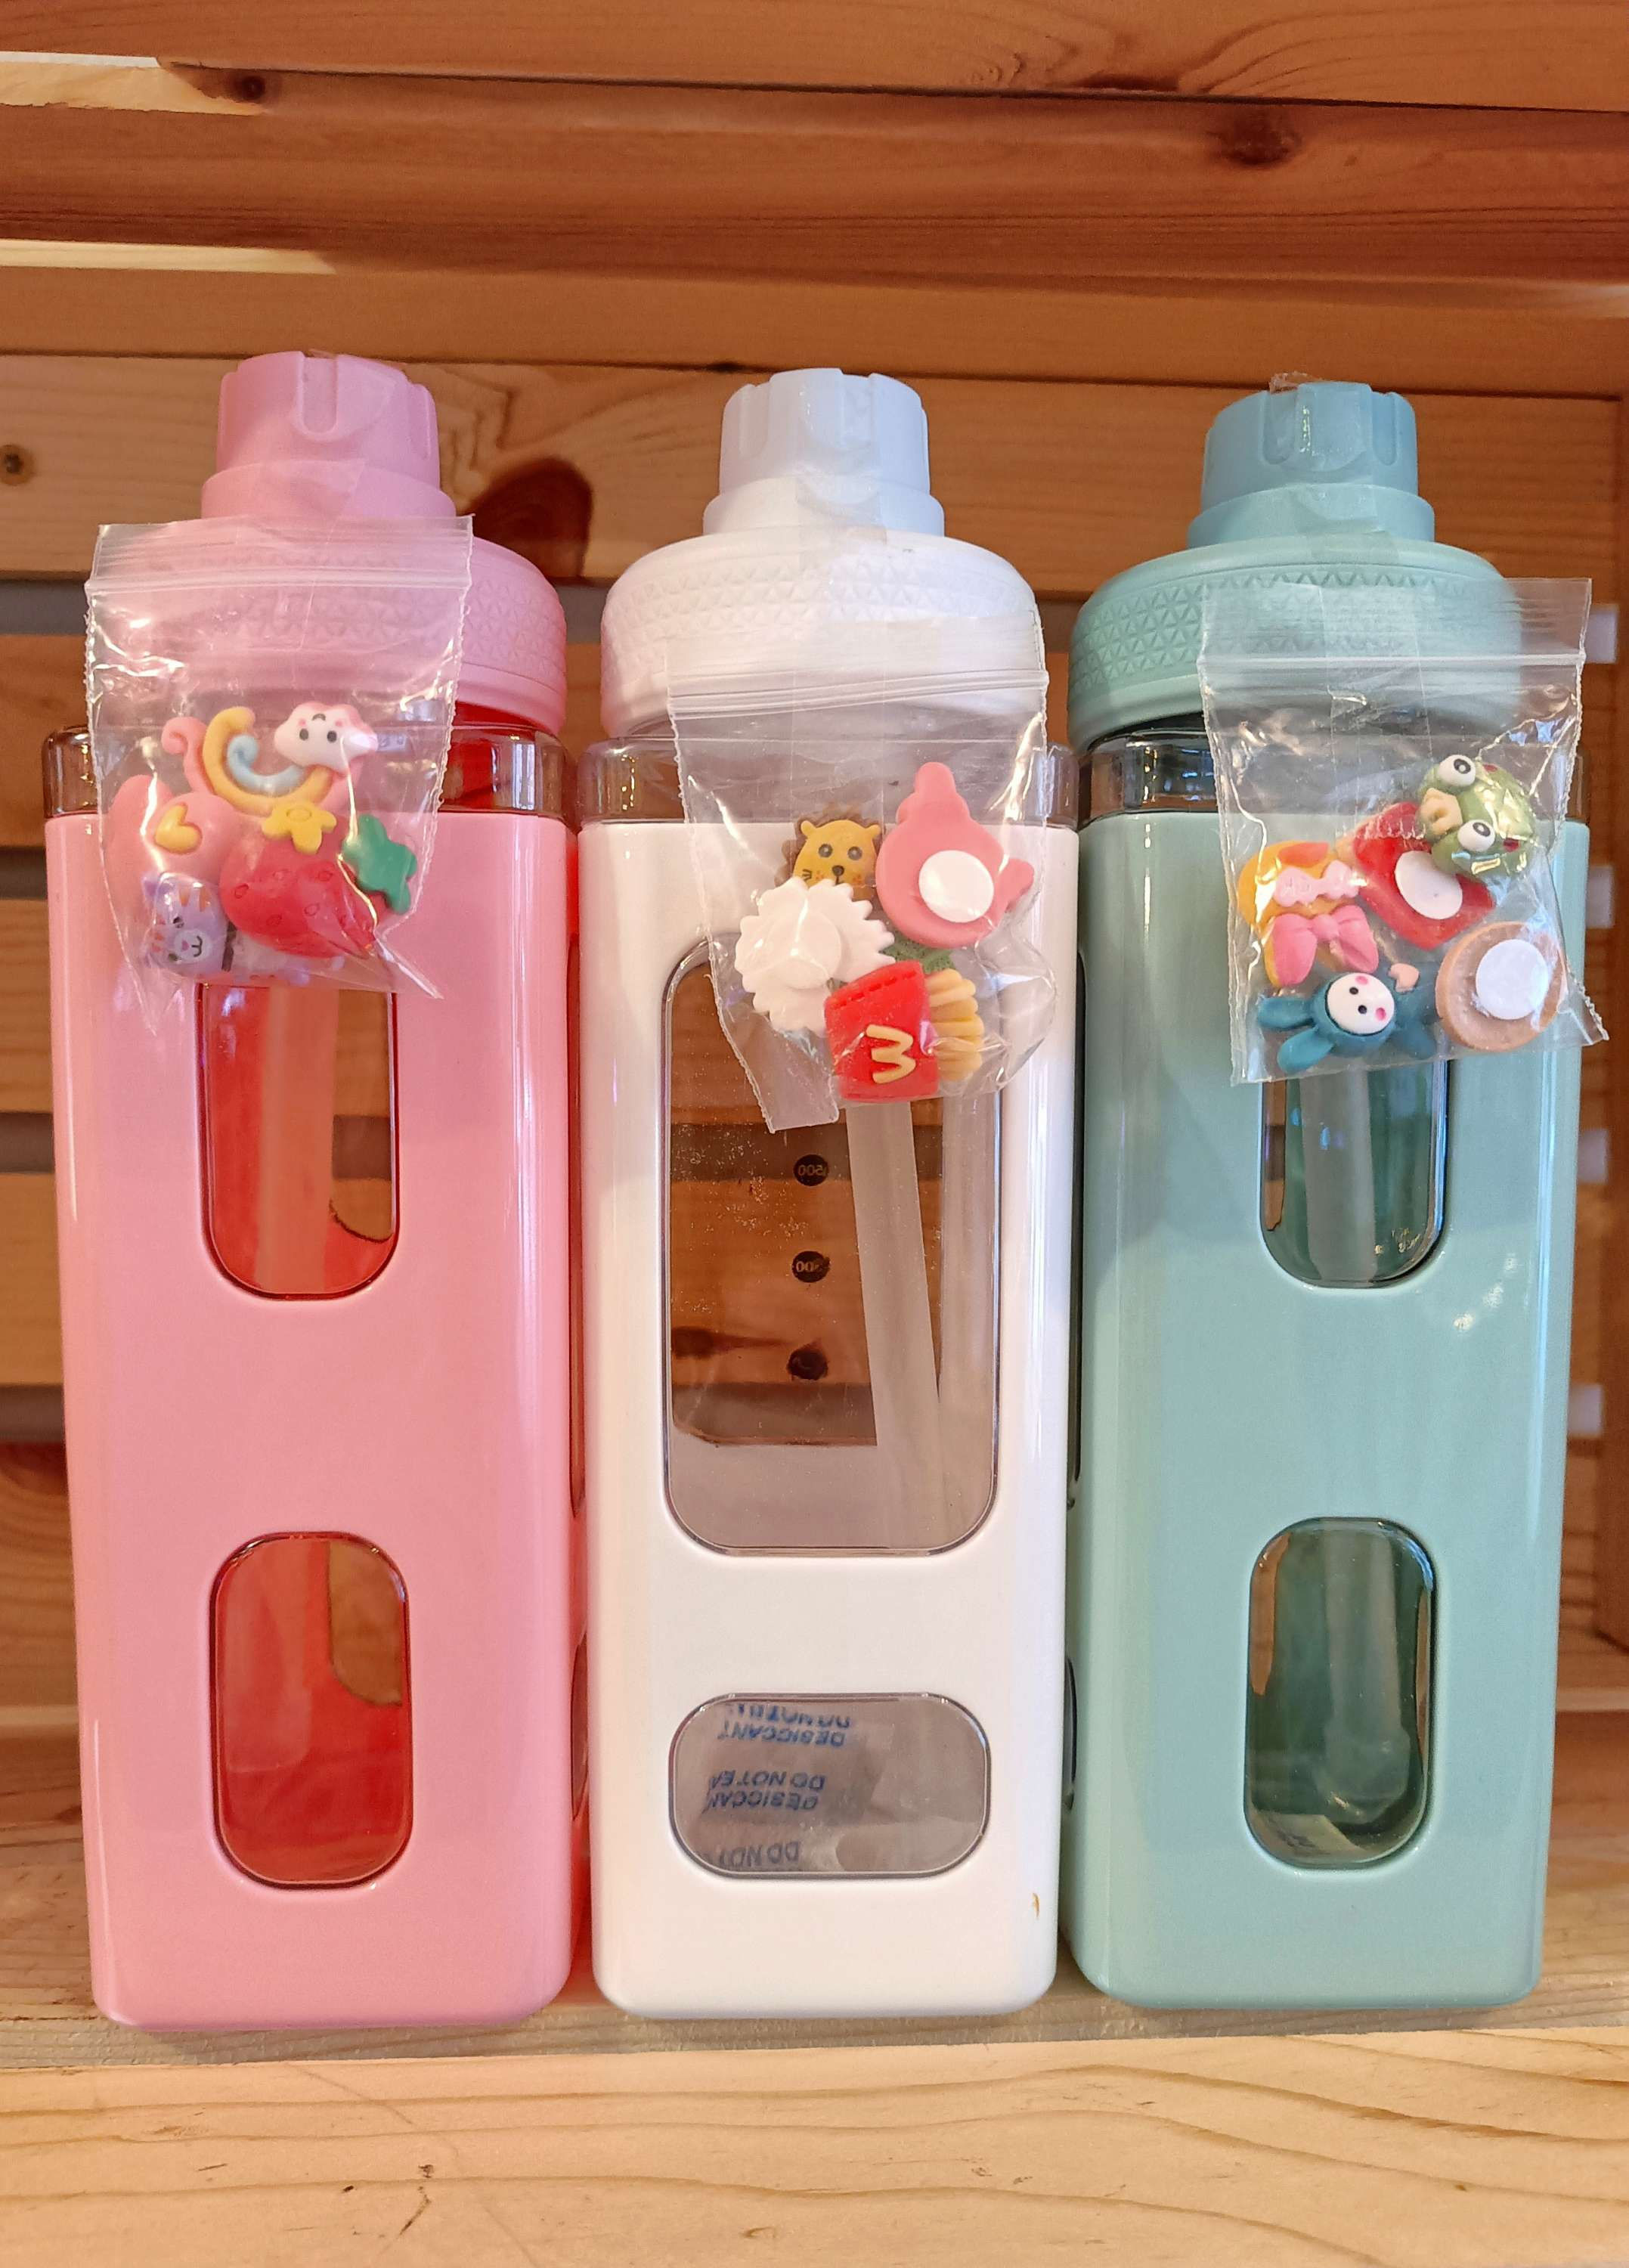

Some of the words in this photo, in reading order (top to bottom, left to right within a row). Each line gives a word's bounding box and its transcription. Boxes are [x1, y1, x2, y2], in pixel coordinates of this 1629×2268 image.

[866, 1024, 916, 1084] M
[717, 1720, 846, 1747] DESICCANT
[736, 1770, 788, 1787] NOT
[790, 1772, 826, 1791] DO
[767, 1841, 800, 1864] DO
